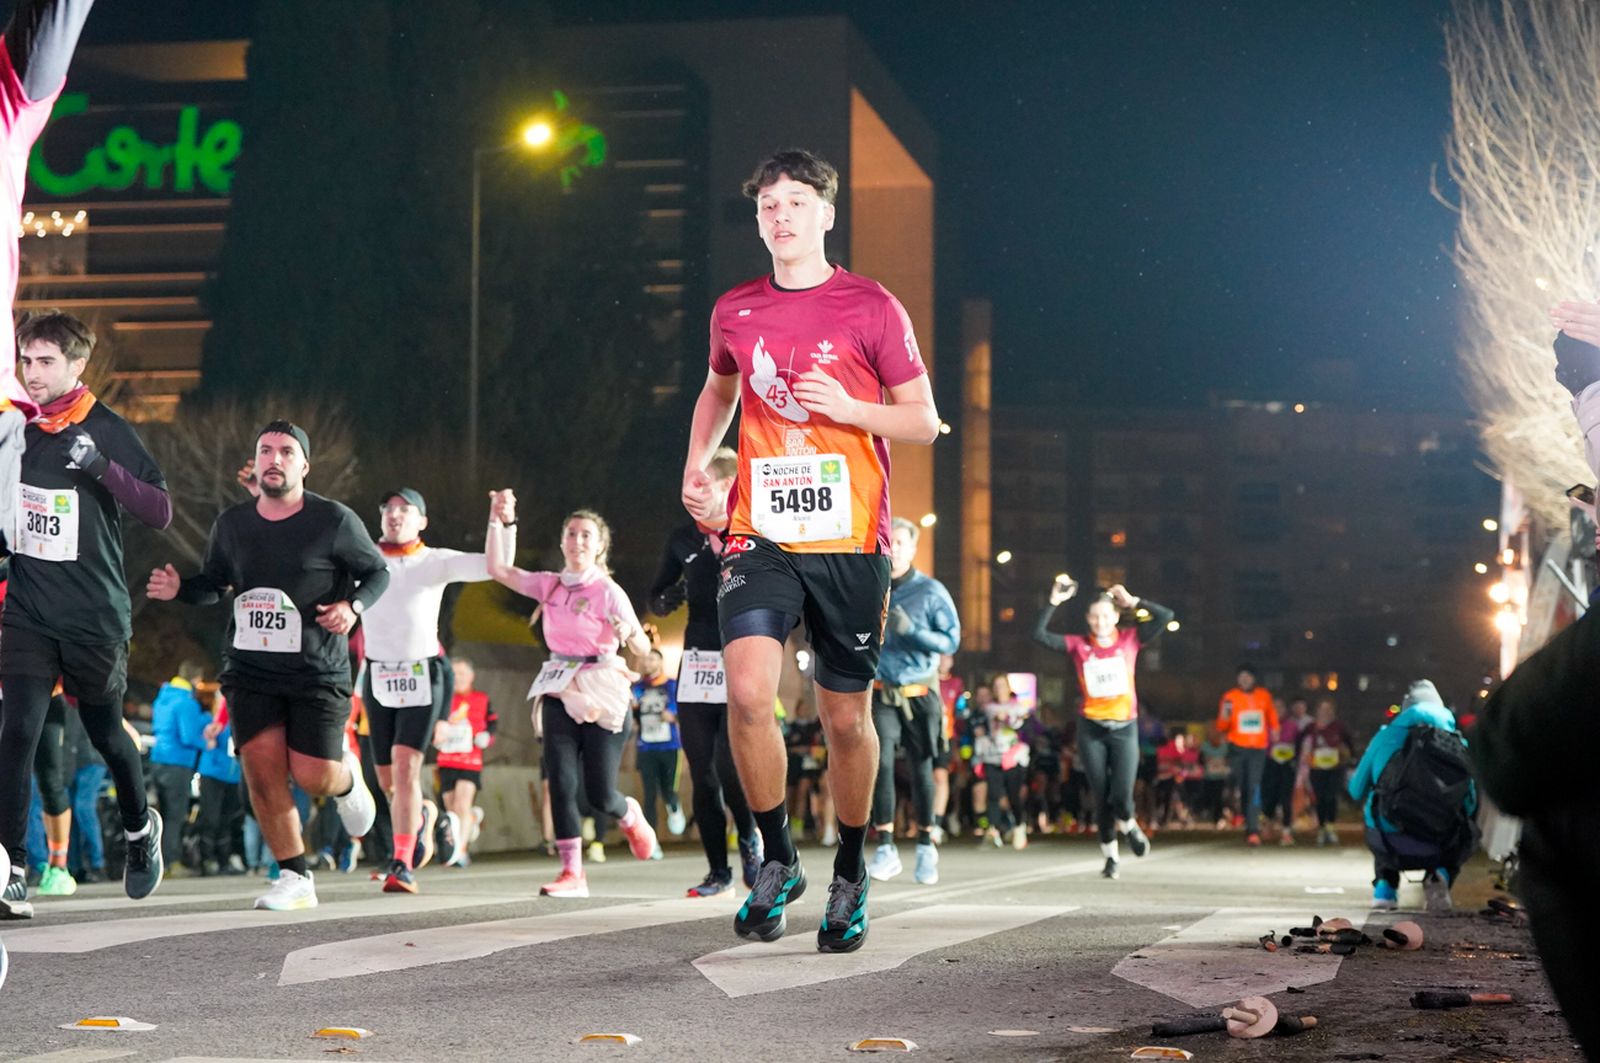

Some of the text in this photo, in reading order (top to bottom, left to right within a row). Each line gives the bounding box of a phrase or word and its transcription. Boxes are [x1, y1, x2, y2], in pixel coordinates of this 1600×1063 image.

[28, 91, 243, 196] Corte
[766, 384, 788, 409] 43
[773, 466, 799, 476] NOCHE
[801, 465, 811, 474] DE
[763, 478, 780, 488] SAN
[771, 486, 832, 514] 5498
[27, 511, 60, 536] 3873
[249, 610, 286, 630] 1825
[386, 678, 417, 692] 1180
[694, 670, 724, 686] 1758
